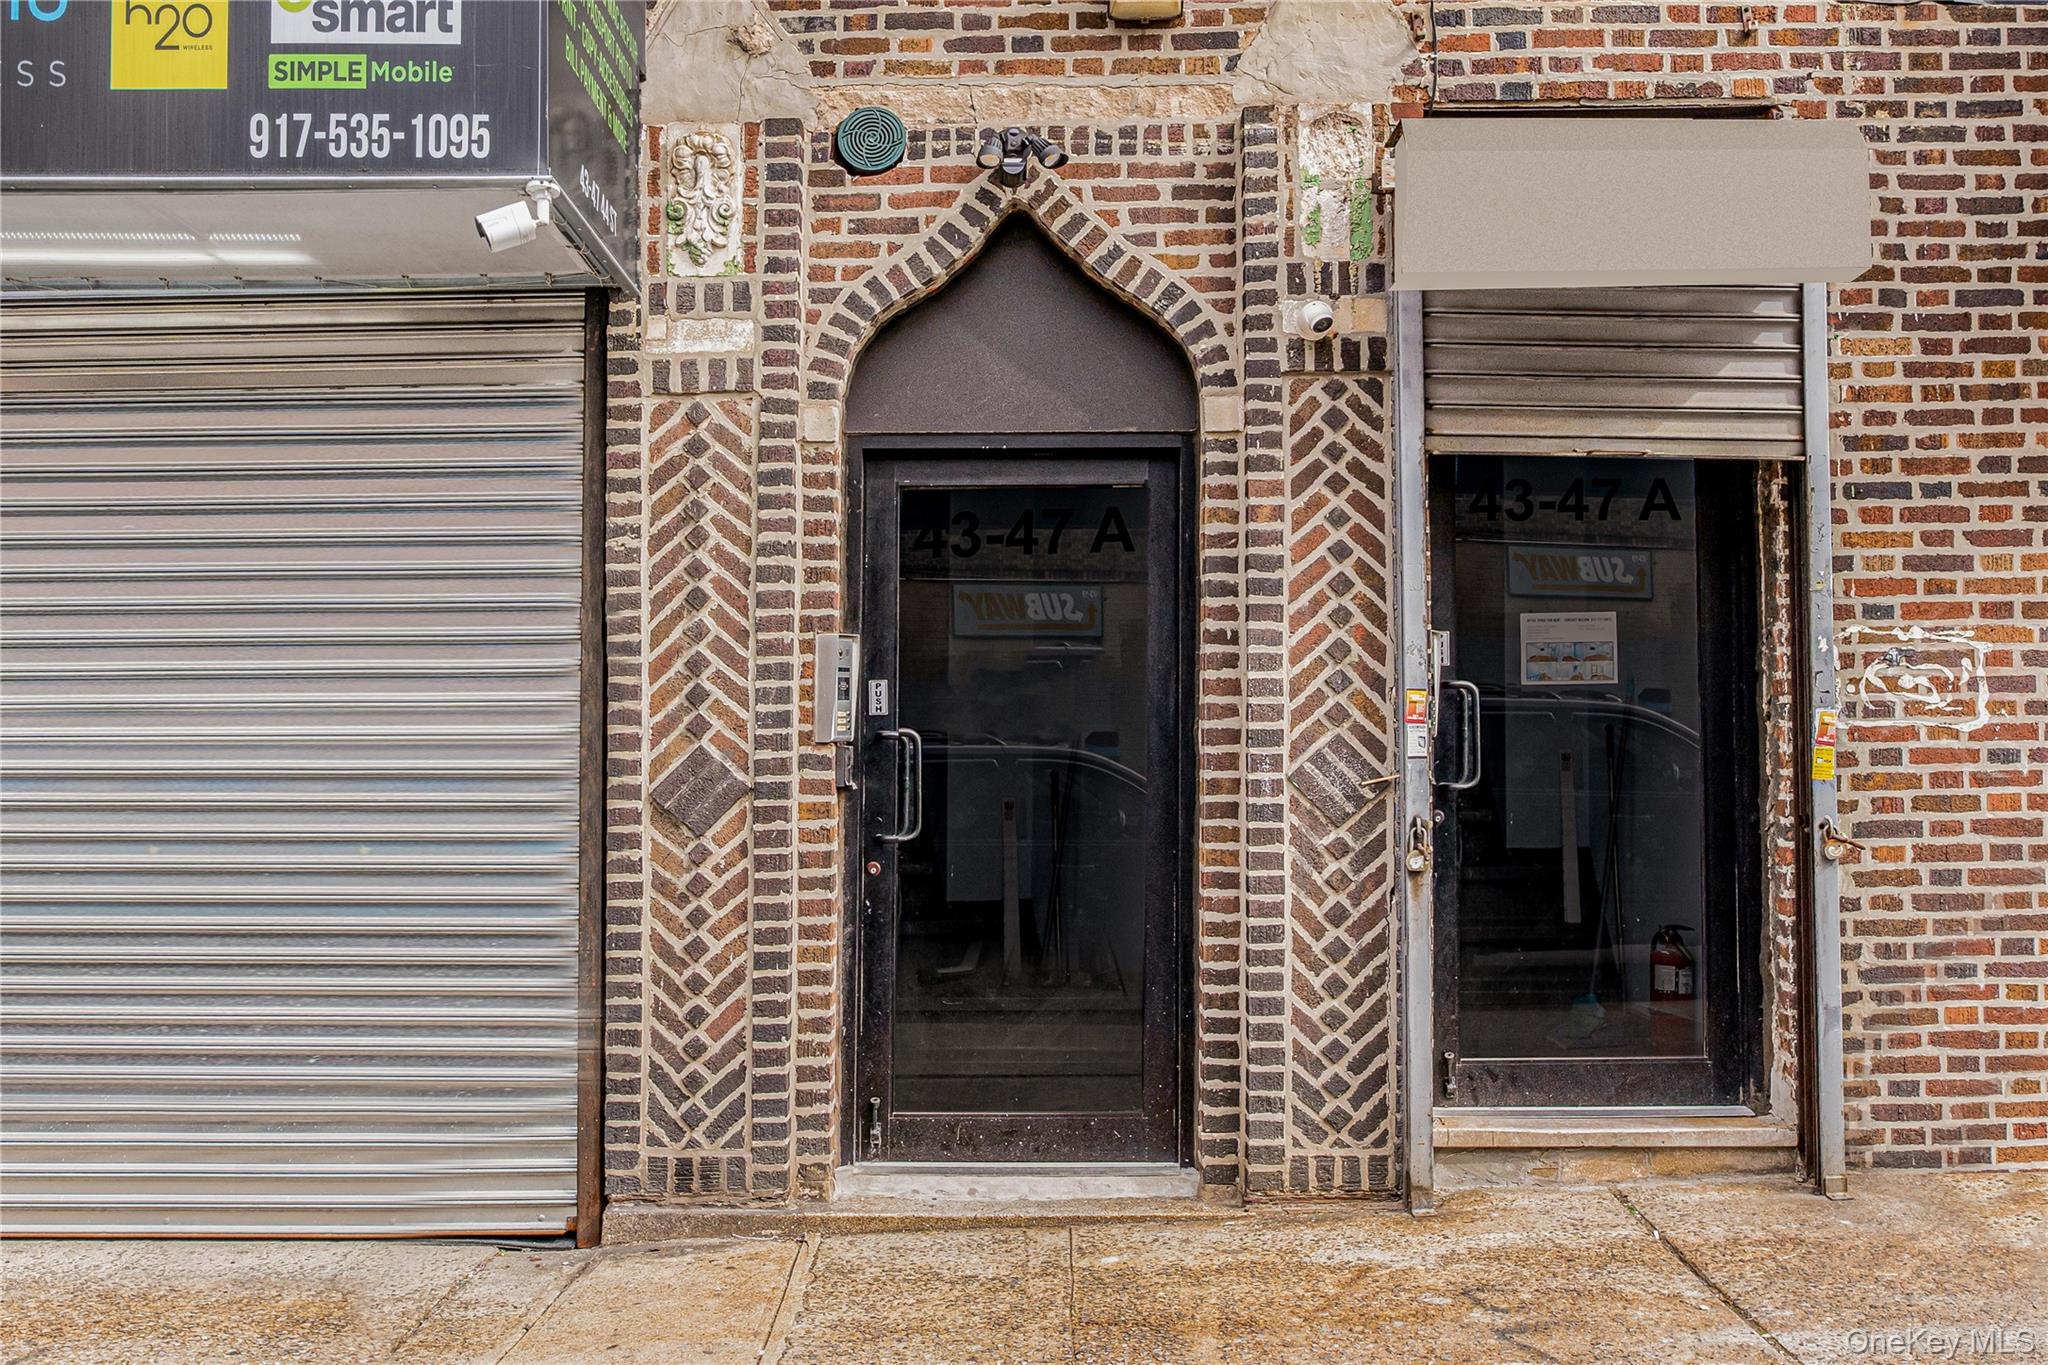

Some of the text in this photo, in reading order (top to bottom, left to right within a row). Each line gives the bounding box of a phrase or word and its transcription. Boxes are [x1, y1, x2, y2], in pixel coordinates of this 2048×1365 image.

[312, 0, 454, 33] smart
[0, 60, 67, 87] SS
[274, 60, 454, 83] SIMPLE Mobile
[580, 57, 608, 121] PAYMENT
[249, 113, 491, 159] 917-535-1095
[580, 164, 617, 237] 43-47 44 ST
[1468, 477, 1682, 522] 43-47 A
[910, 506, 1136, 558] 43-47 A
